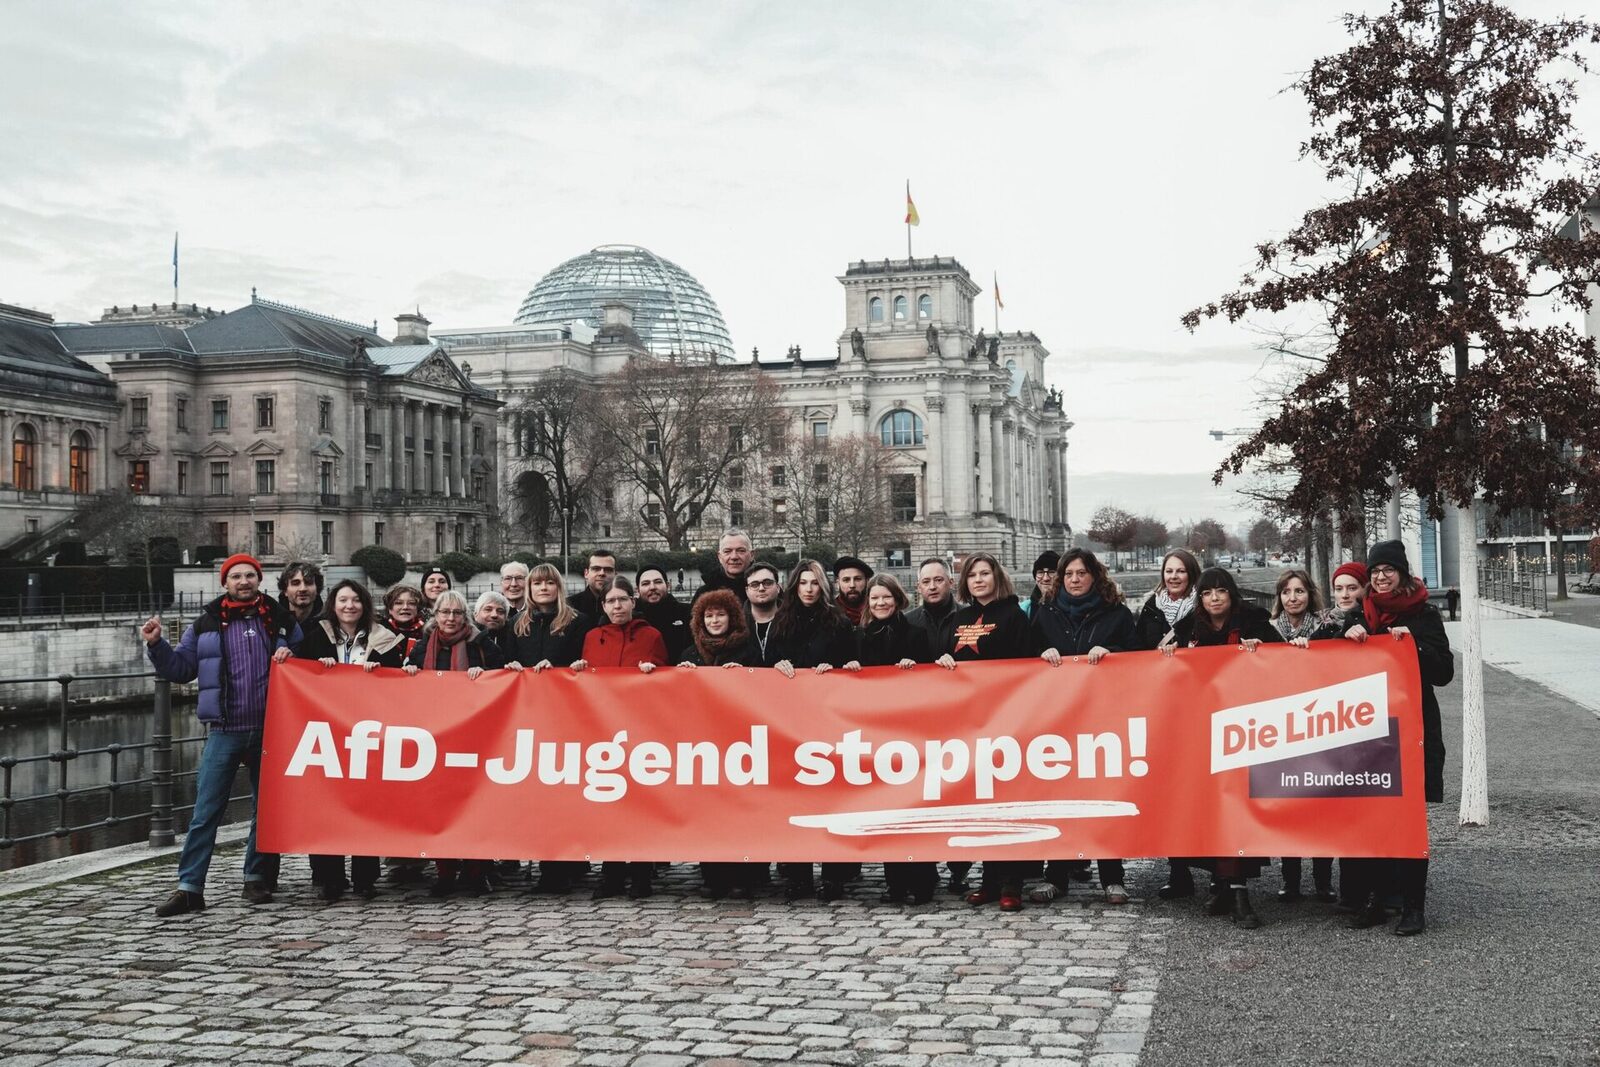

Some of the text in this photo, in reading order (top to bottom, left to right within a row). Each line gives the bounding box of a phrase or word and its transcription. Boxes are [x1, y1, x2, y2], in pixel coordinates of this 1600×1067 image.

[1222, 698, 1376, 756] Die Linke
[284, 716, 1150, 803] AfD-Jugend stoppen!
[1280, 770, 1392, 789] Im Bundestag
